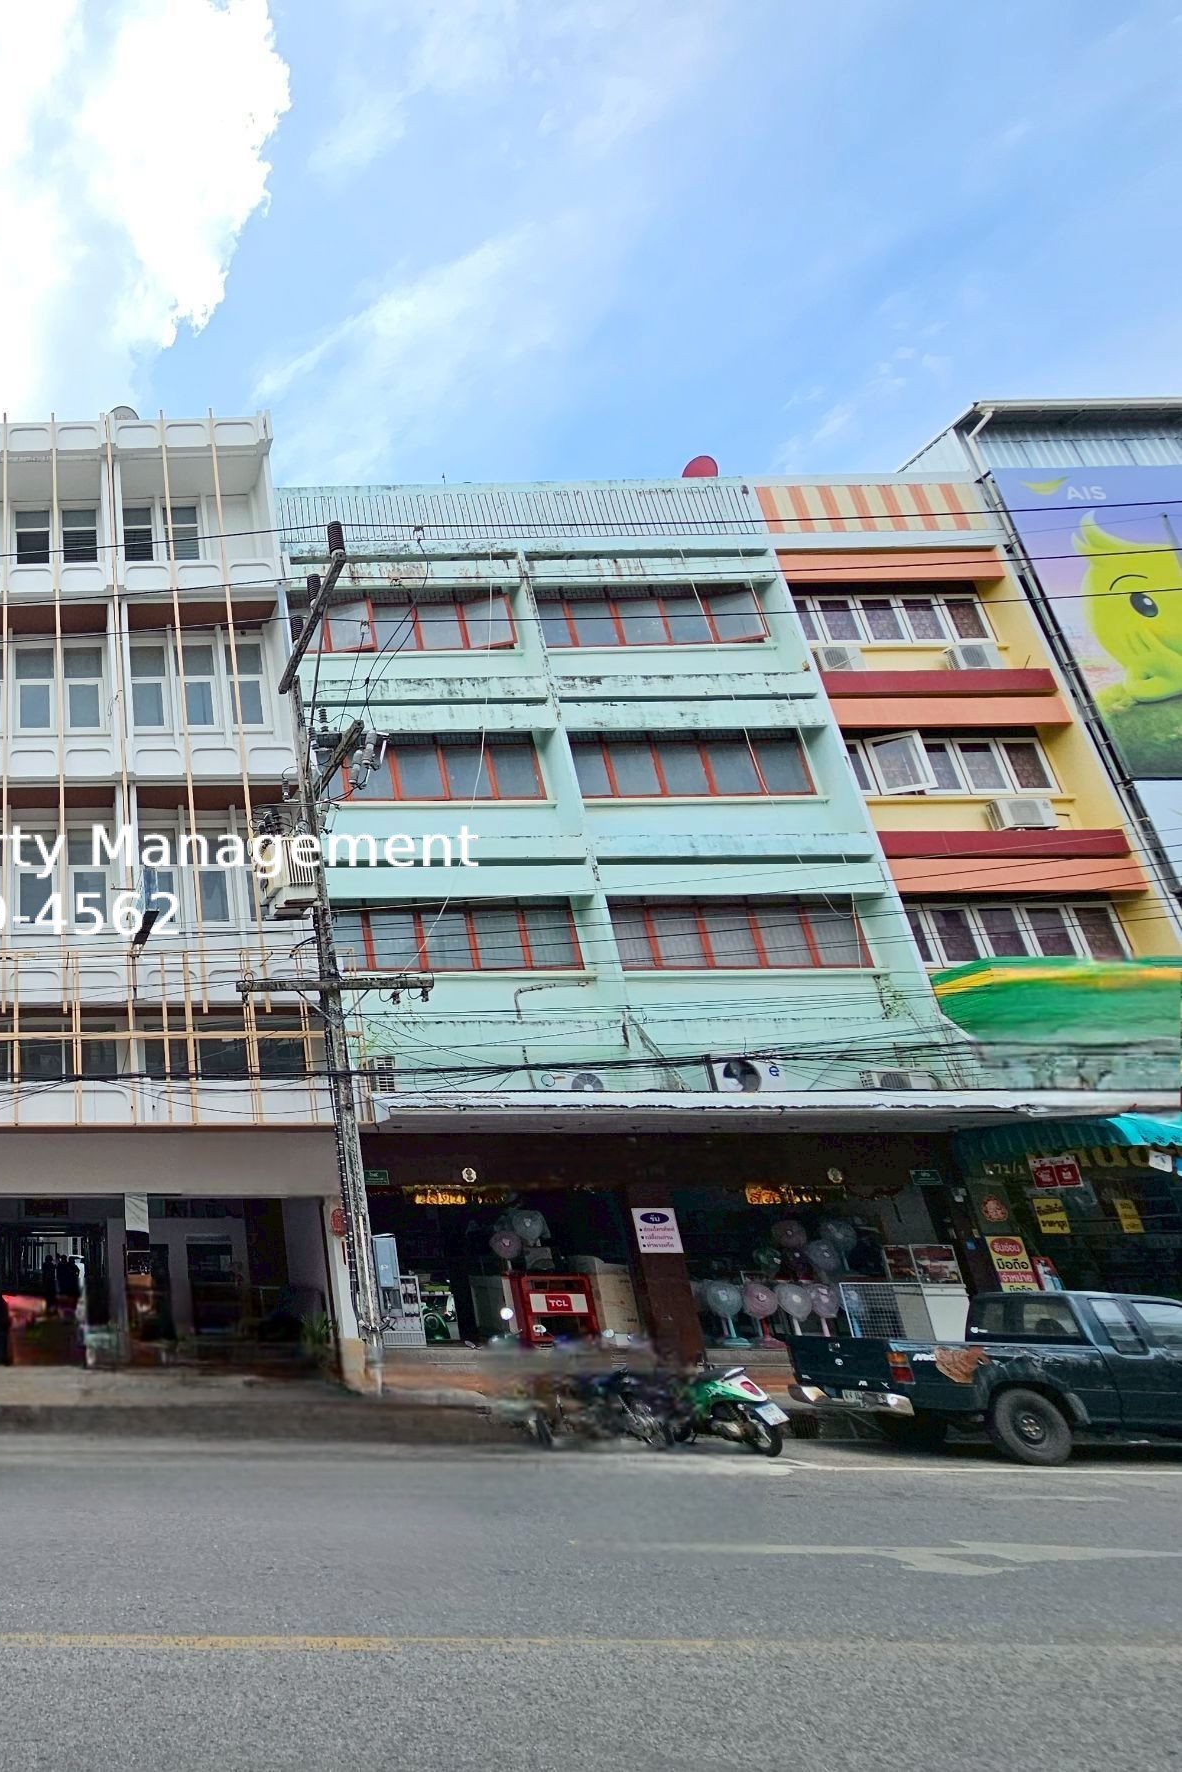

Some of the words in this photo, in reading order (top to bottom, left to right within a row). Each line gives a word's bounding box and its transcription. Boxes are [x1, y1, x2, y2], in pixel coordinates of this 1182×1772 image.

[1066, 485, 1107, 501] AIS
[996, 1257, 1029, 1270] มือถือ
[1000, 1272, 1033, 1283] จำหน่าย
[548, 1299, 569, 1307] TCL
